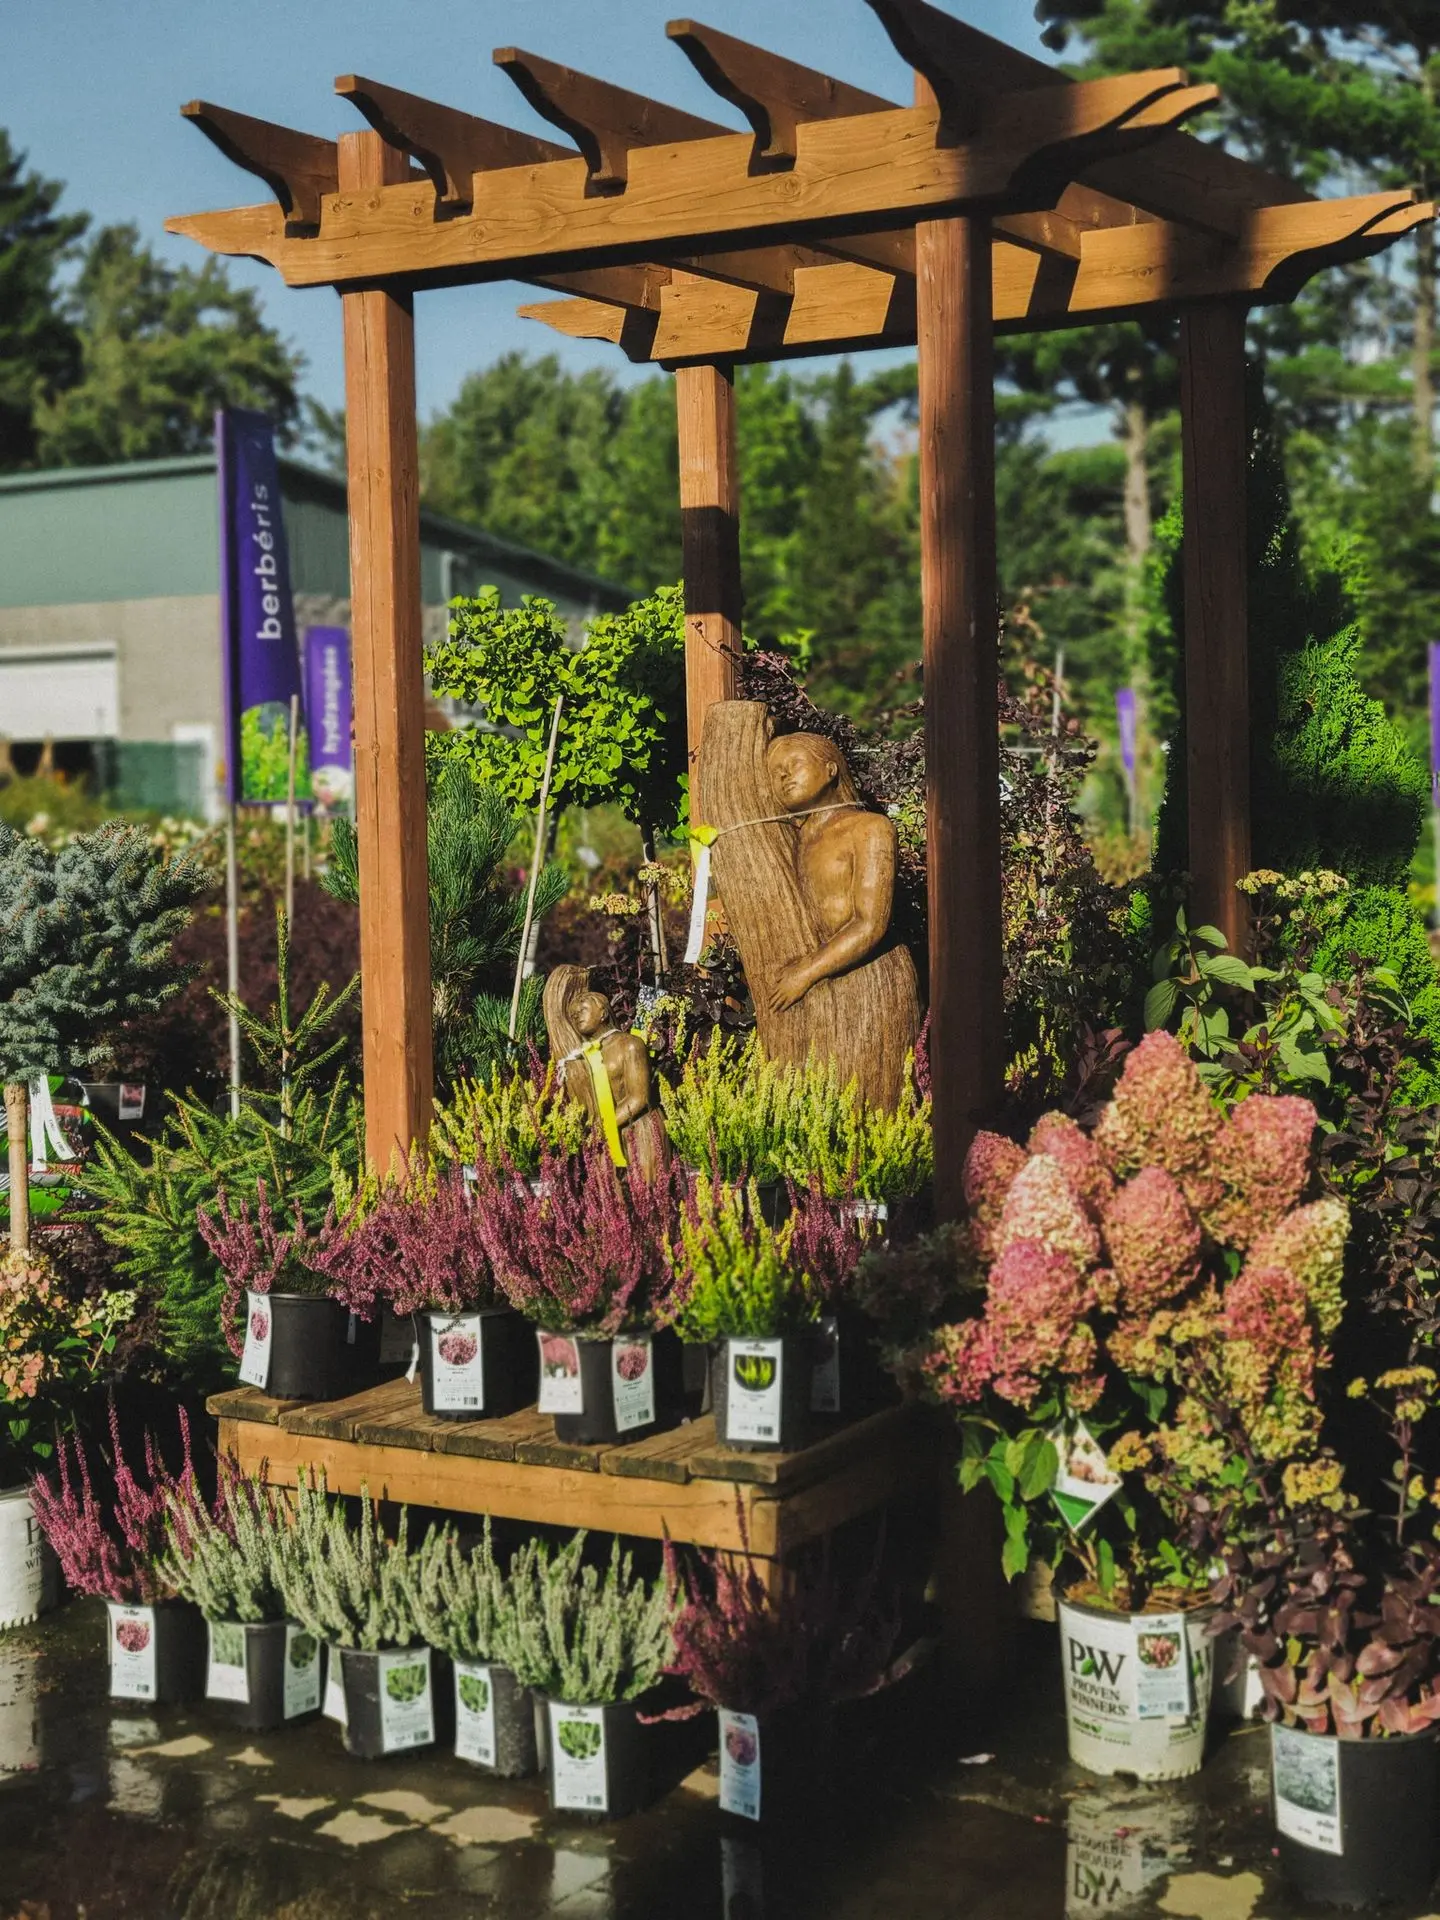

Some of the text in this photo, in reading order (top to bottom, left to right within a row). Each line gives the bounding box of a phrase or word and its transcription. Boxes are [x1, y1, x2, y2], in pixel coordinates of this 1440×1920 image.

[251, 484, 281, 640] berbéris
[1067, 1636, 1127, 1686] PW
[1070, 1687, 1128, 1717] WINNERS
[1072, 1676, 1121, 1701] PROVEN
